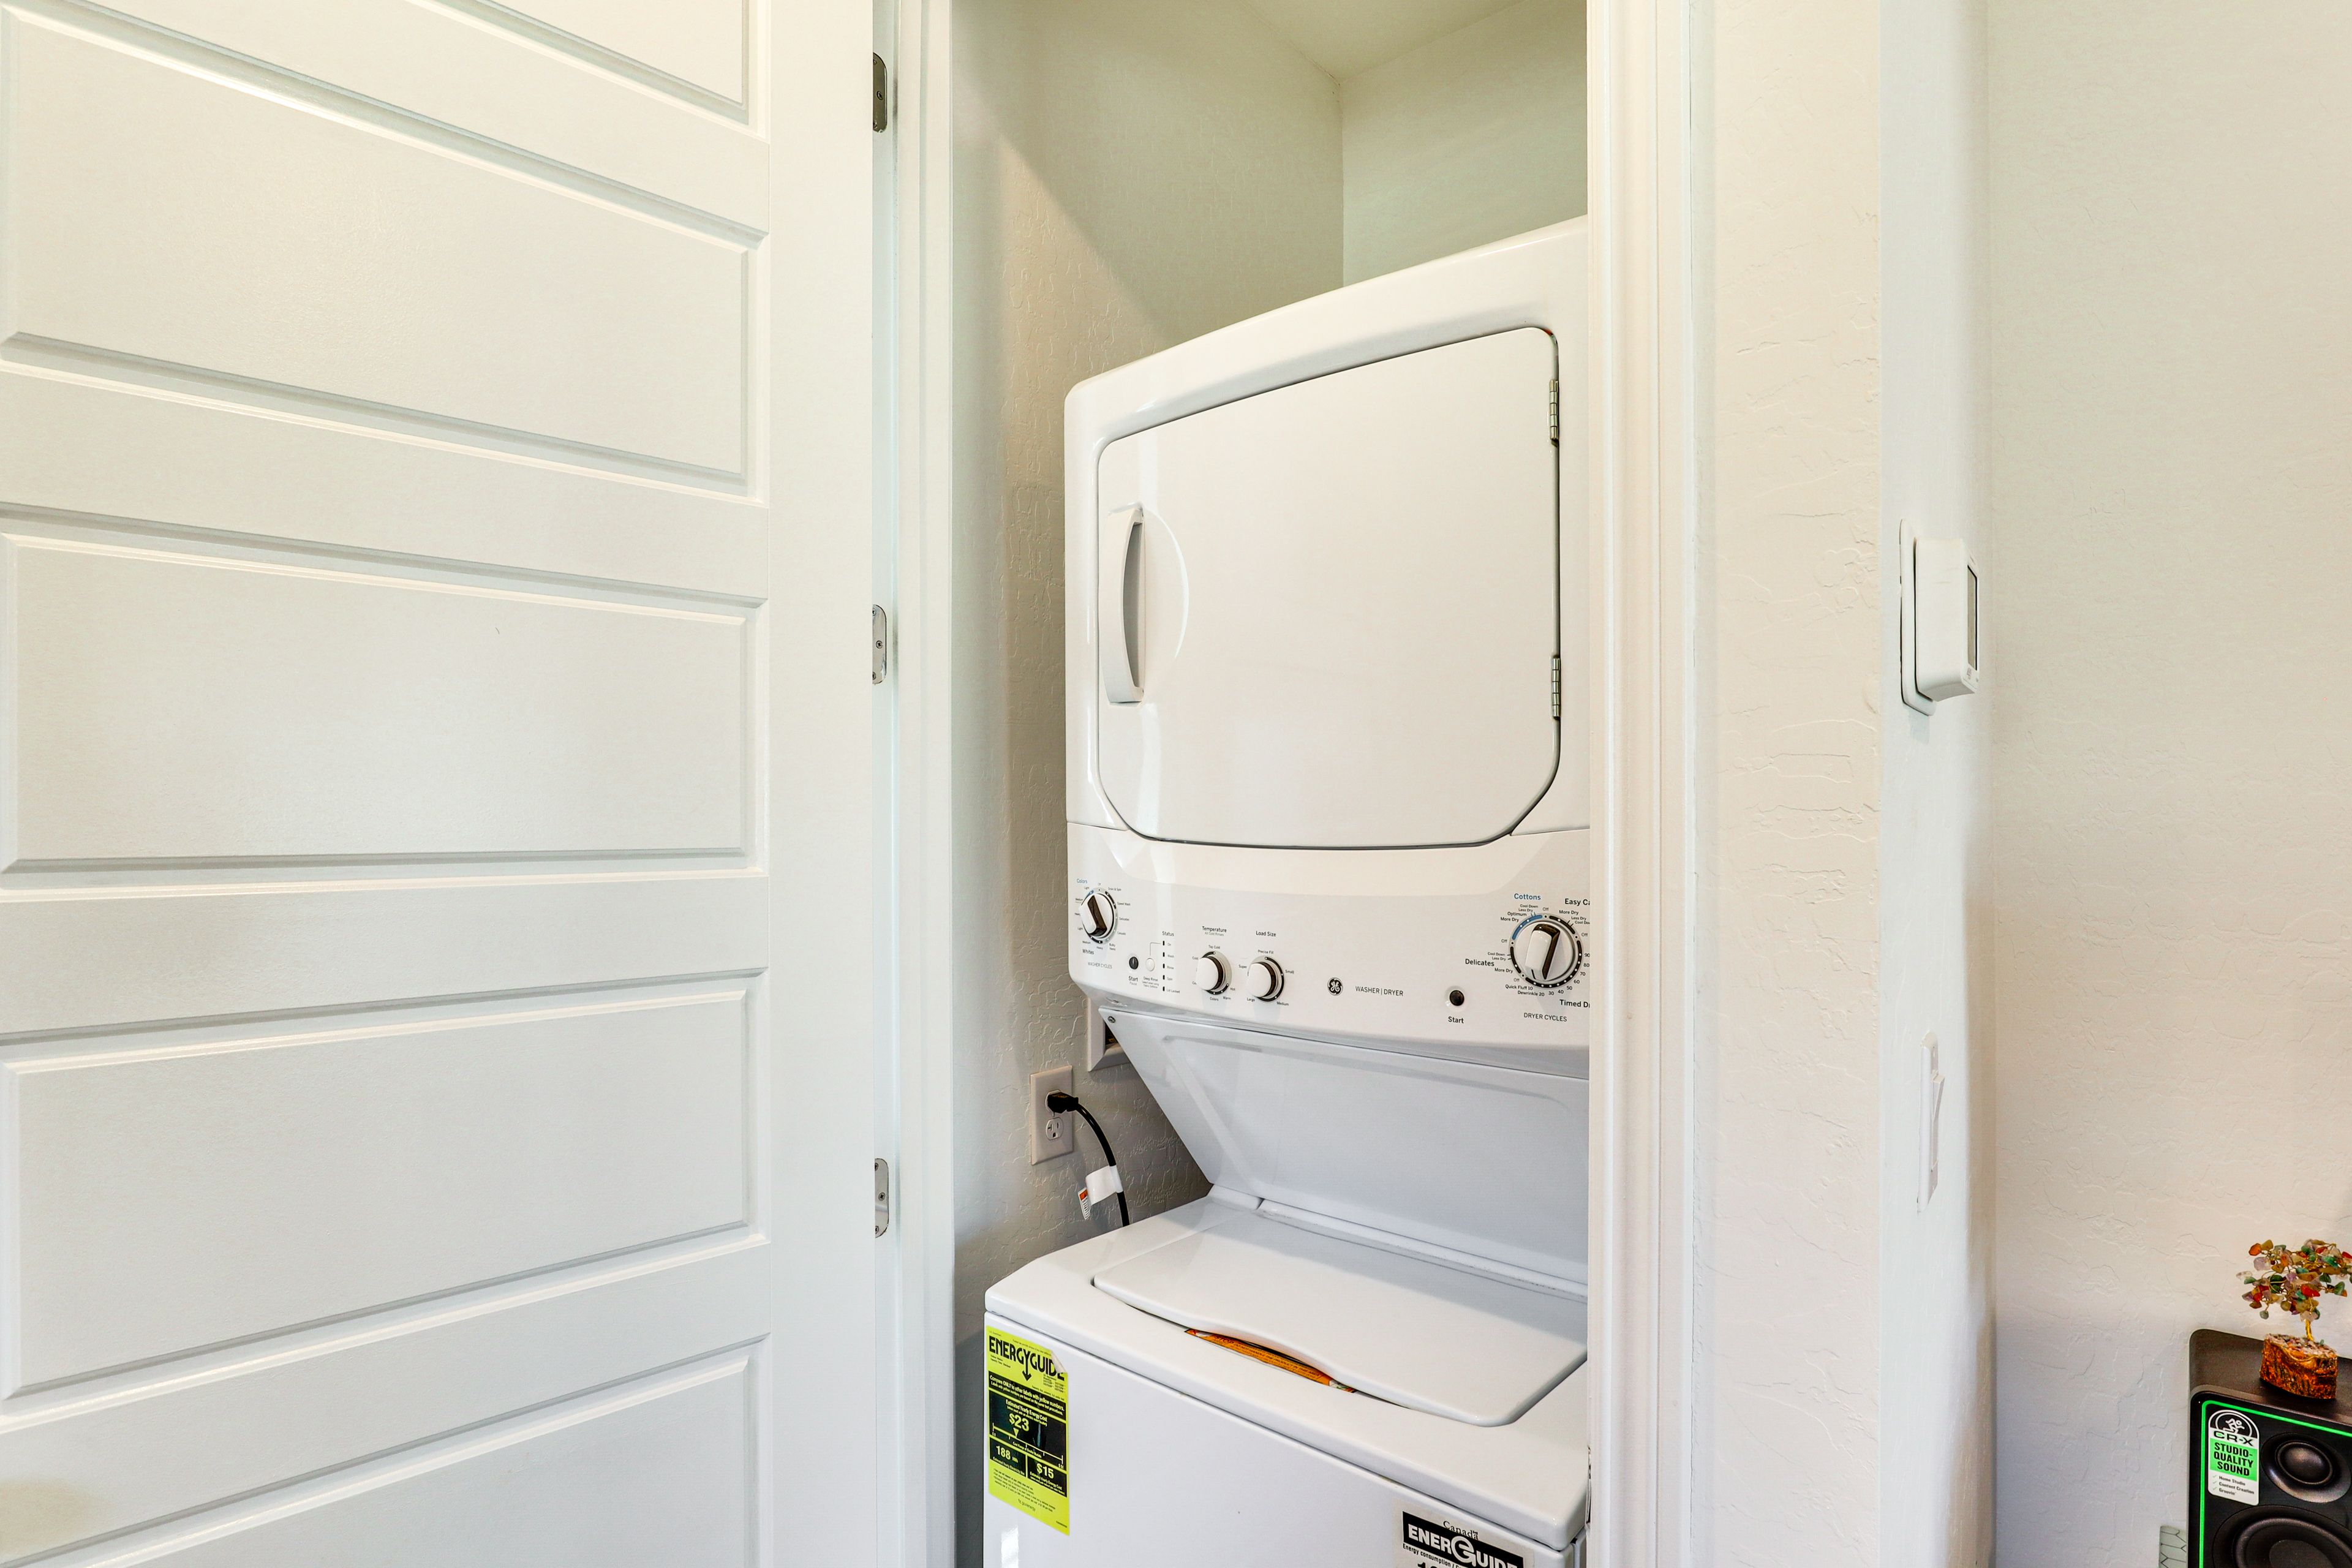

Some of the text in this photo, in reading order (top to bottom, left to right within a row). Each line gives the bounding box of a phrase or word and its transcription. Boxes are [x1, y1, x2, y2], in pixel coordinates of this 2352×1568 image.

[990, 1374, 1002, 1385] Compare
[1039, 1396, 1049, 1406] yellow
[1006, 1399, 1019, 1409] Estimated
[1020, 1405, 1028, 1414] Yearly
[1029, 1409, 1039, 1419] Energy
[1009, 1413, 1029, 1431] $23
[2214, 1430, 2254, 1447] CR-X
[996, 1446, 1011, 1460] 188
[2215, 1442, 2253, 1458] STUDIO-
[2214, 1452, 2253, 1468] QUALITY
[1036, 1463, 1054, 1479] $15
[2217, 1461, 2250, 1476] SOUND
[2236, 1486, 2255, 1494] Creation
[1443, 1521, 1479, 1540] Canada
[1403, 1544, 1419, 1555] Energy
[1420, 1551, 1450, 1567] consumption
